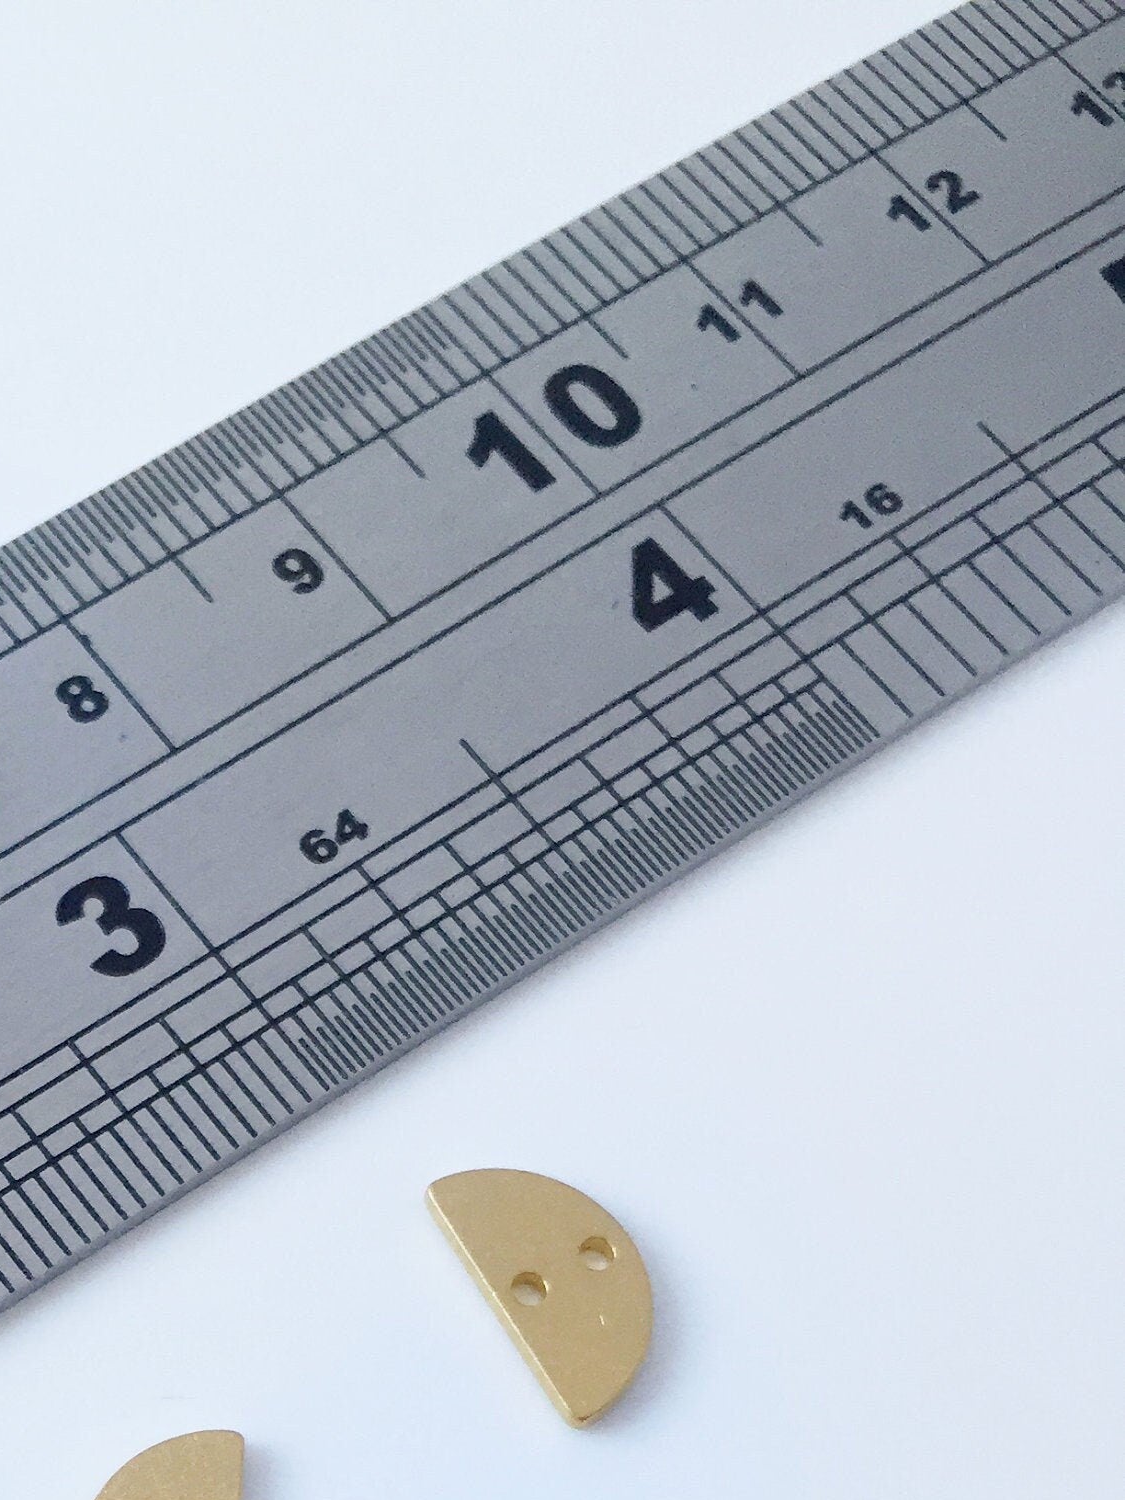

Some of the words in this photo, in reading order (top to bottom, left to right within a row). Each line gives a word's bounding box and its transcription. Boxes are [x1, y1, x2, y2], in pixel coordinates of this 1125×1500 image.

[887, 170, 980, 232] 12
[697, 279, 784, 343] 11
[466, 363, 643, 493] 10
[839, 483, 904, 529] 16
[272, 548, 325, 595] 9
[631, 536, 719, 633] 4
[55, 675, 110, 724] 8
[300, 808, 370, 864] 64
[55, 875, 167, 978] 3
